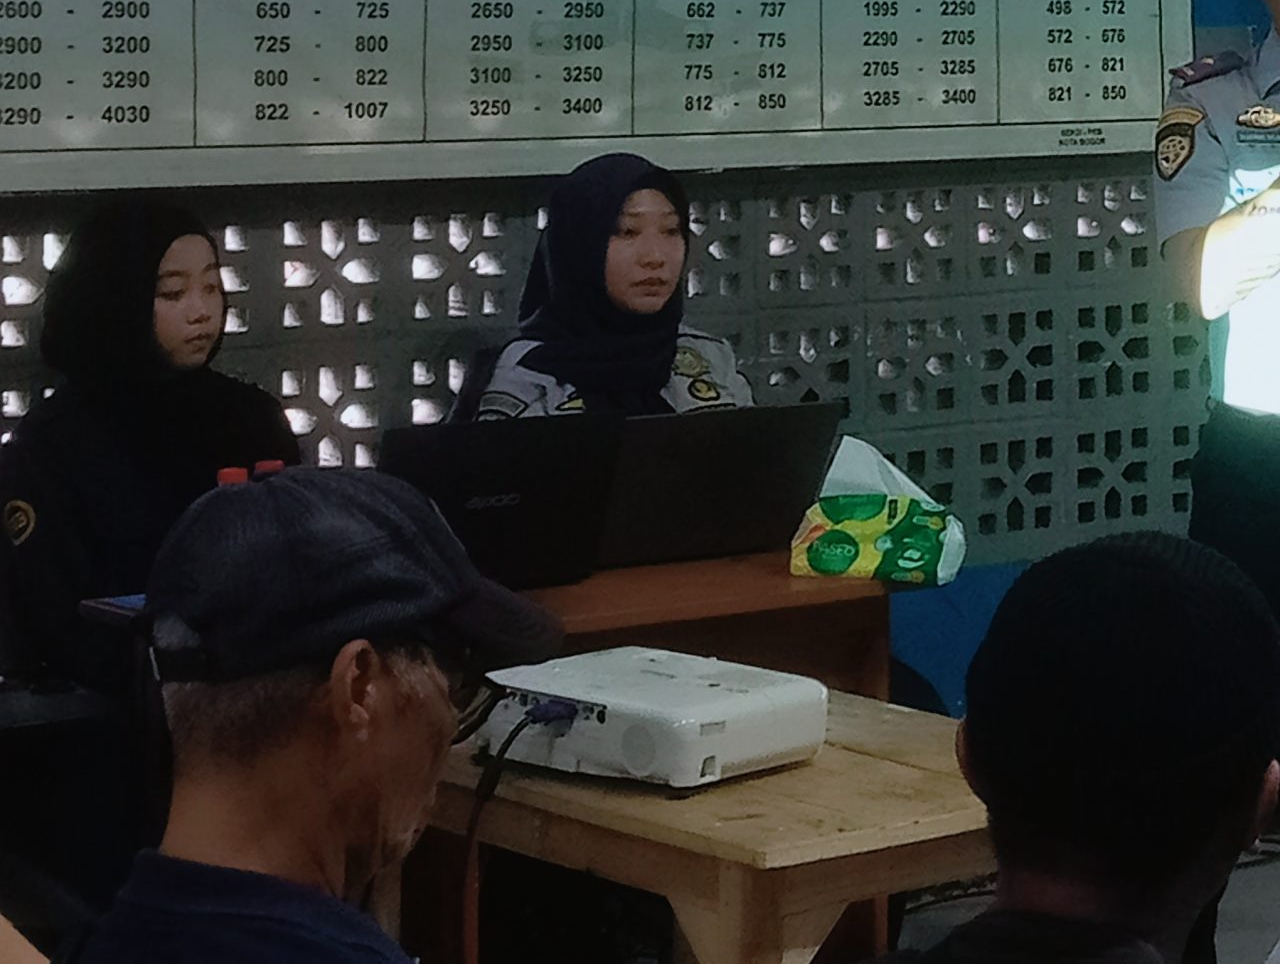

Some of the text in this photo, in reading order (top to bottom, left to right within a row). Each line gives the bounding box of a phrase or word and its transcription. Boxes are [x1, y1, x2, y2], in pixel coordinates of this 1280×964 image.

[101, 0, 151, 20] 2900
[255, 1, 390, 20] 650 725
[470, 1, 605, 20] 2650 2950
[686, 1, 787, 19] 662 737
[863, 0, 976, 18] 1995 2290
[1045, 0, 1126, 16] 498 572
[862, 29, 976, 47] 2290 2705
[1046, 27, 1126, 45] 572 676
[683, 63, 714, 81] 775
[861, 58, 976, 78] 2705 3285
[1047, 56, 1125, 74] 676 821
[101, 70, 151, 89] 3290
[253, 68, 389, 88] 800 822
[469, 65, 604, 85] 3100 3250
[863, 88, 977, 107] 3285 3400
[1047, 84, 1127, 102] 821 850
